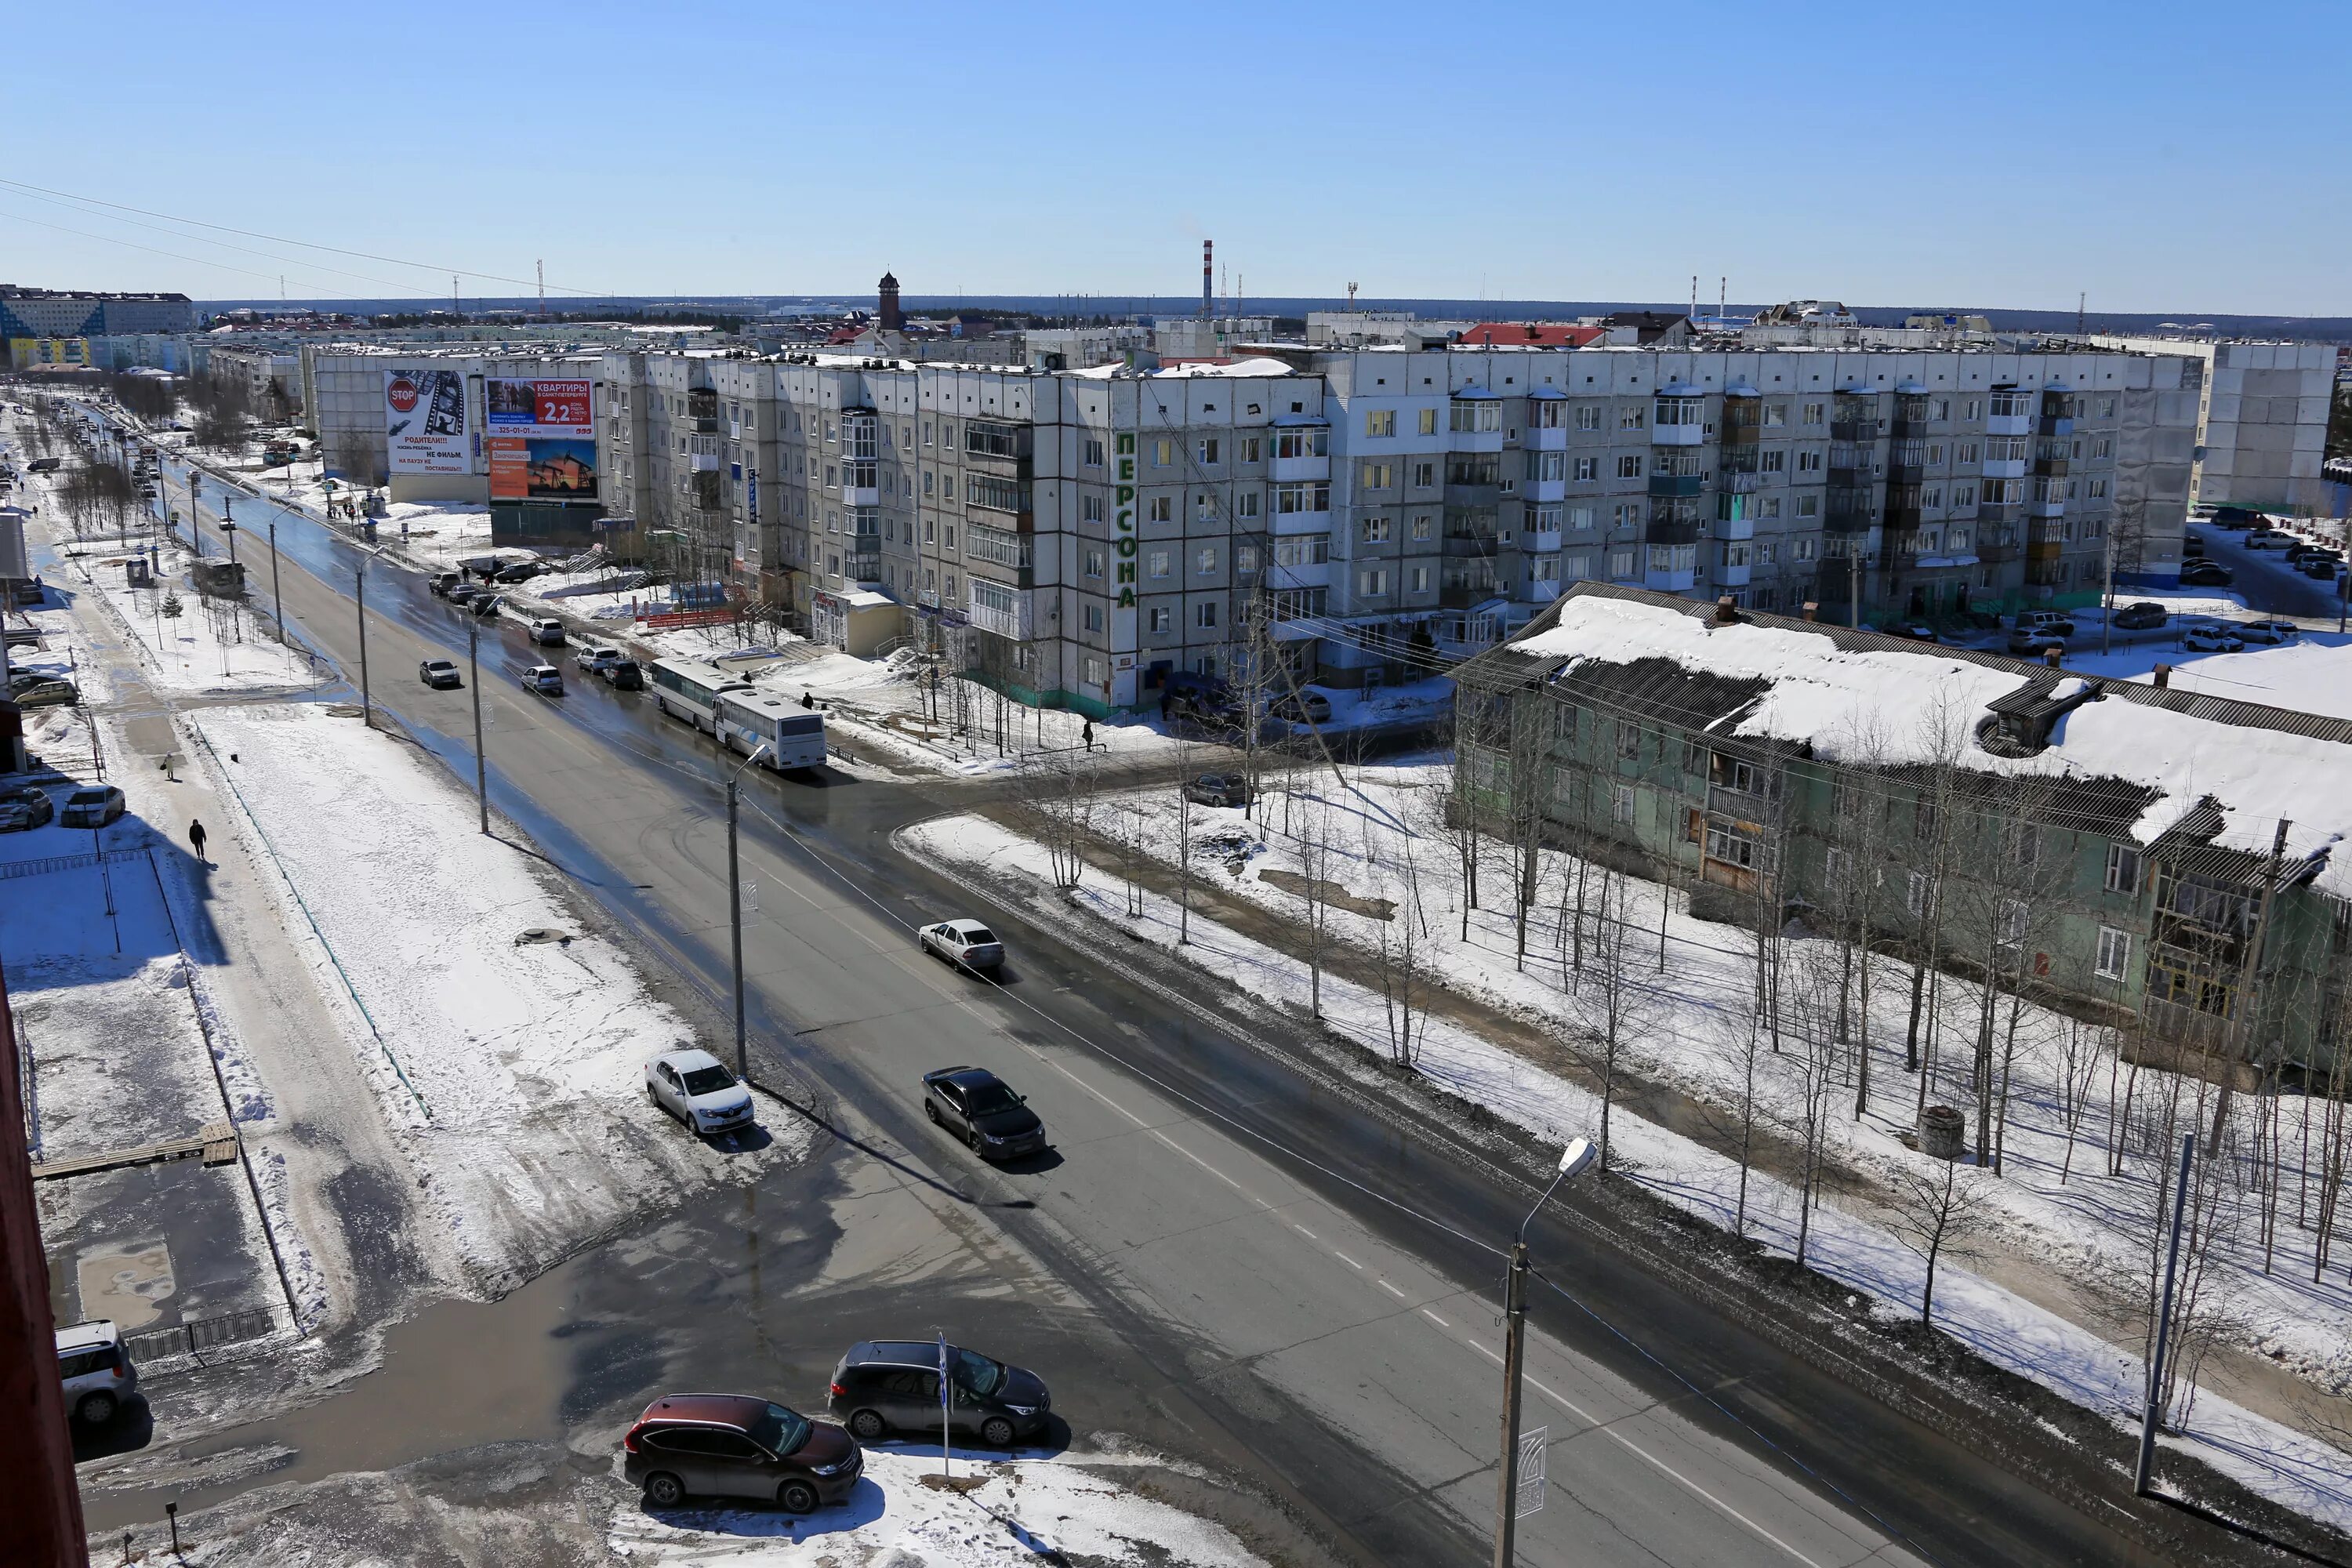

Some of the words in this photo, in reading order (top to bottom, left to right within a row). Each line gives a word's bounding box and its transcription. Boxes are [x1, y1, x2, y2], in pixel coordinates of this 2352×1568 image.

[391, 390, 415, 400] STOP
[537, 383, 587, 392] КВАРТИРЫ
[544, 401, 570, 423] 2,2
[1117, 433, 1137, 609] ПЕРСОНА
